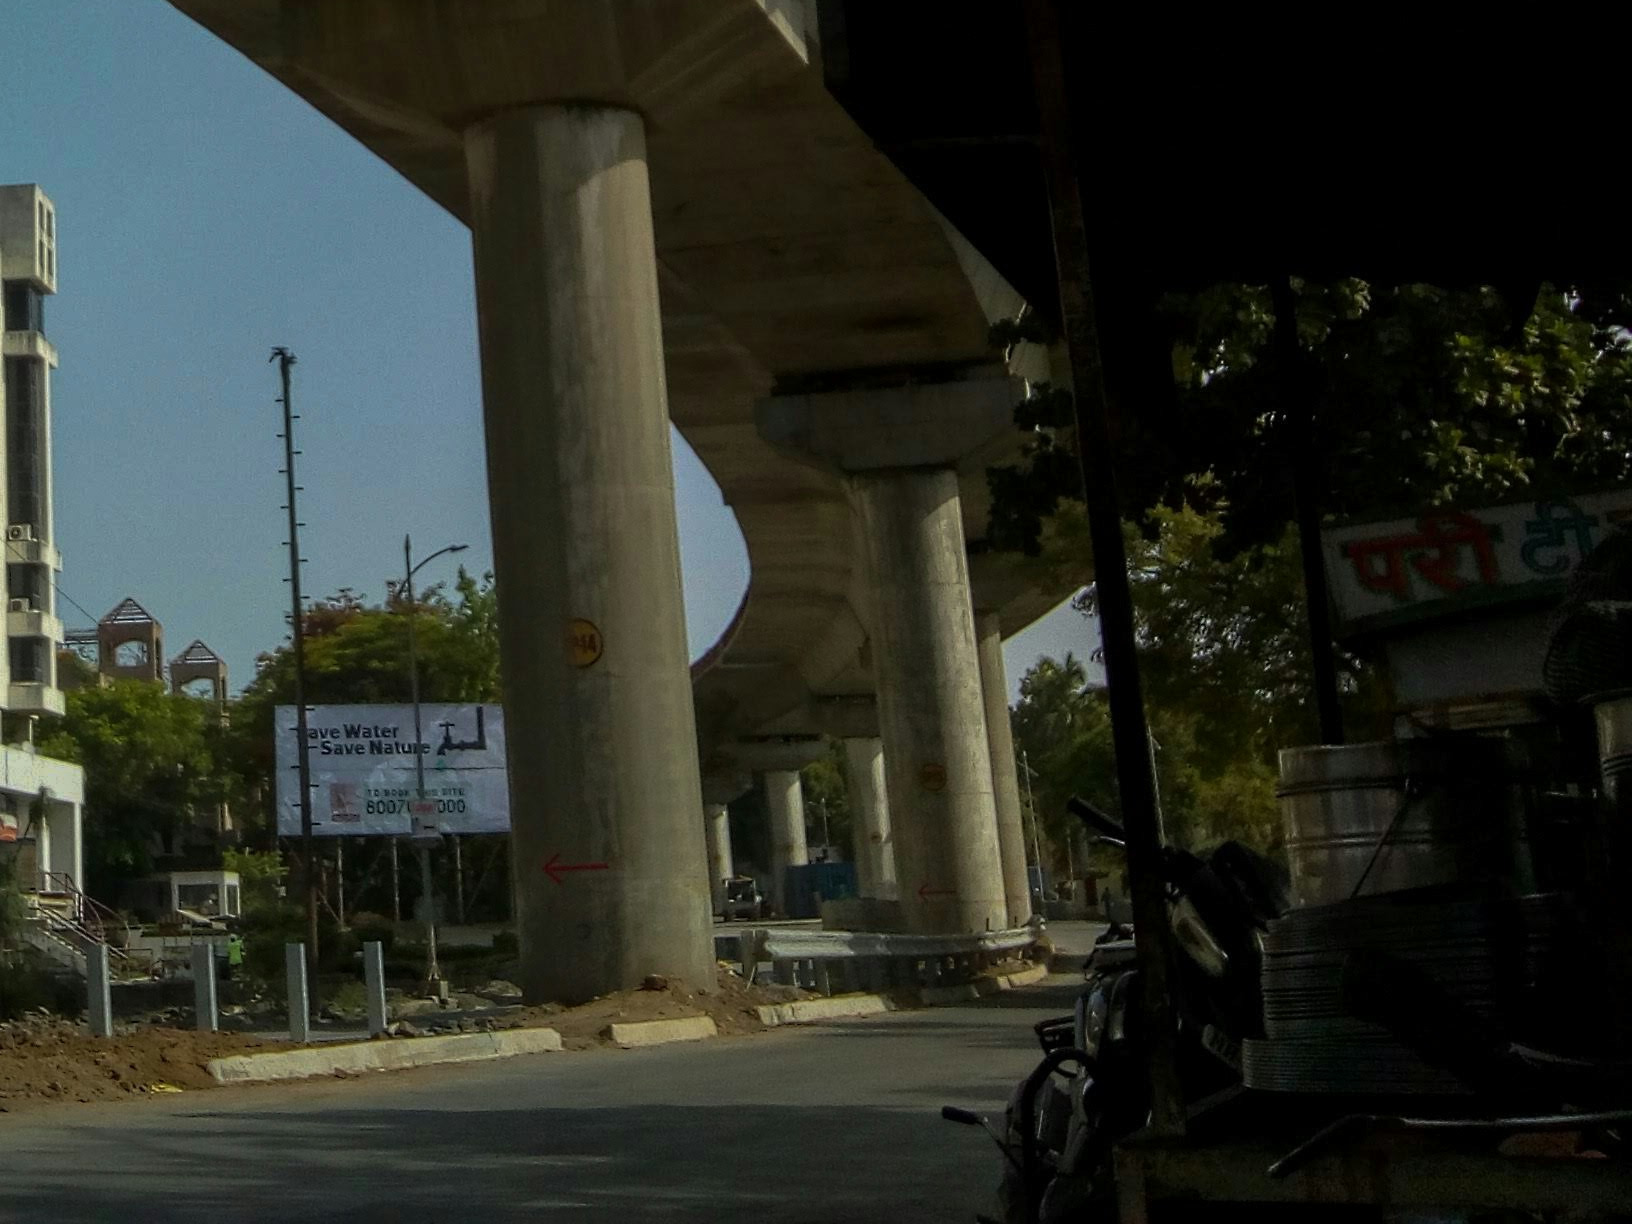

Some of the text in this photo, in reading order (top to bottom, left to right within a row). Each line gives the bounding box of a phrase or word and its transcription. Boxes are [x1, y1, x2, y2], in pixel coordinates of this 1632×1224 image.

[308, 724, 399, 739] ave Water
[321, 740, 431, 755] Save Nature
